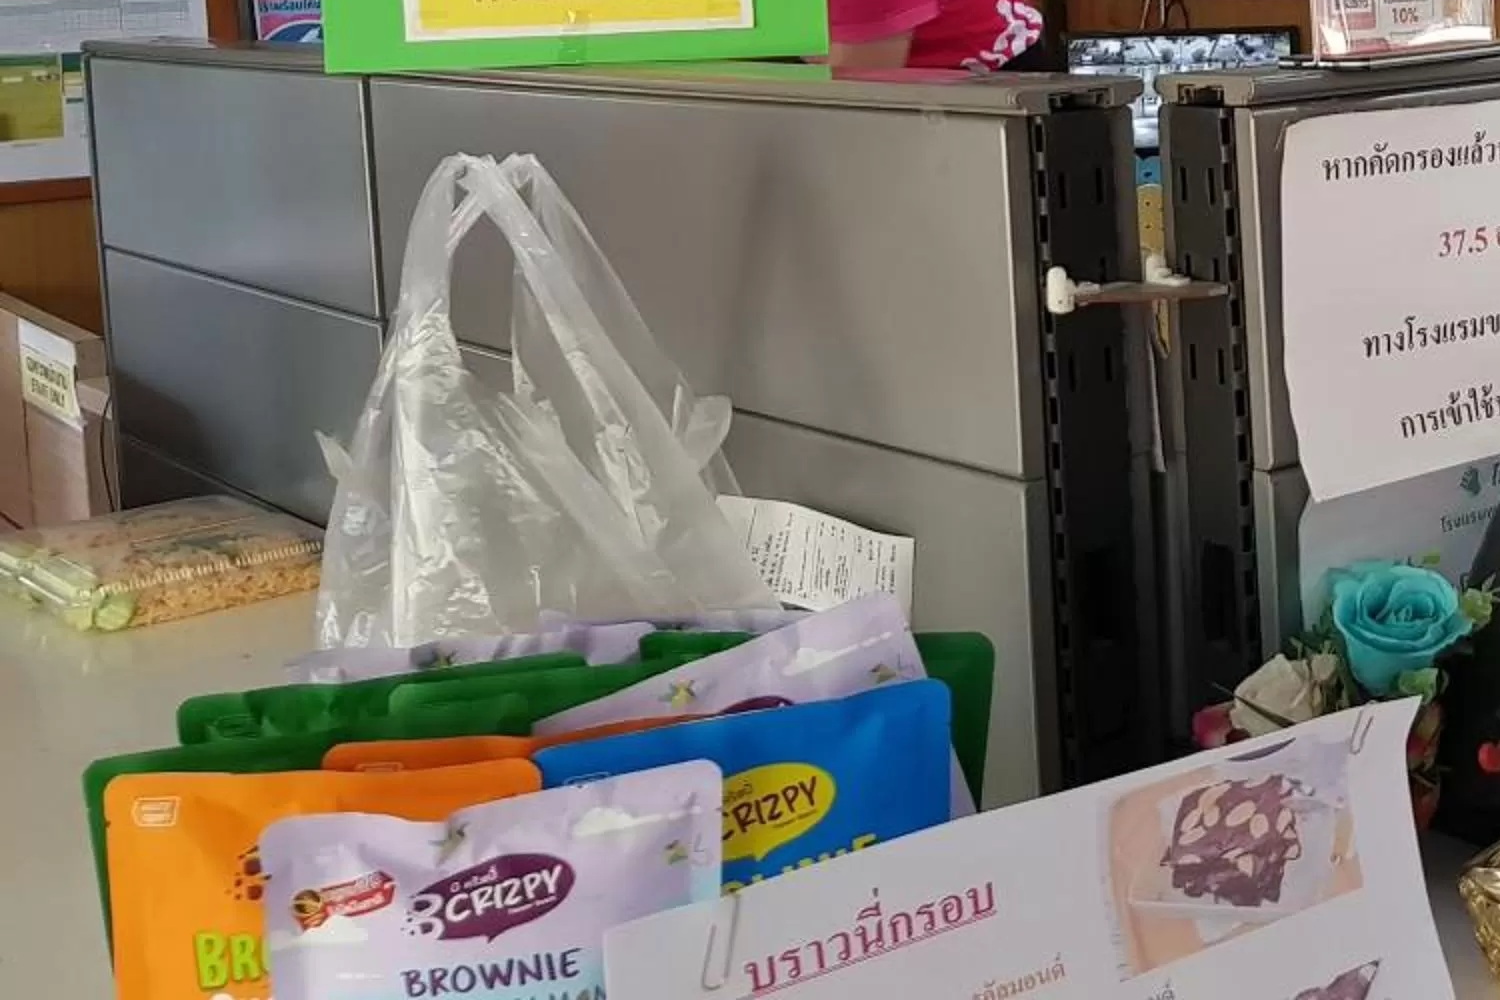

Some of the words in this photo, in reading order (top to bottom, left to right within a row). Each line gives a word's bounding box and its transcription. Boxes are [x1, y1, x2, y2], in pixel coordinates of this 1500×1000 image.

[1390, 6, 1420, 25] 10%
[1437, 227, 1489, 258] 37.5
[445, 864, 564, 921] CRIZPY
[194, 930, 272, 990] BR
[744, 881, 998, 994] บราวนี่กรอบ
[400, 947, 583, 998] BROWNIE
